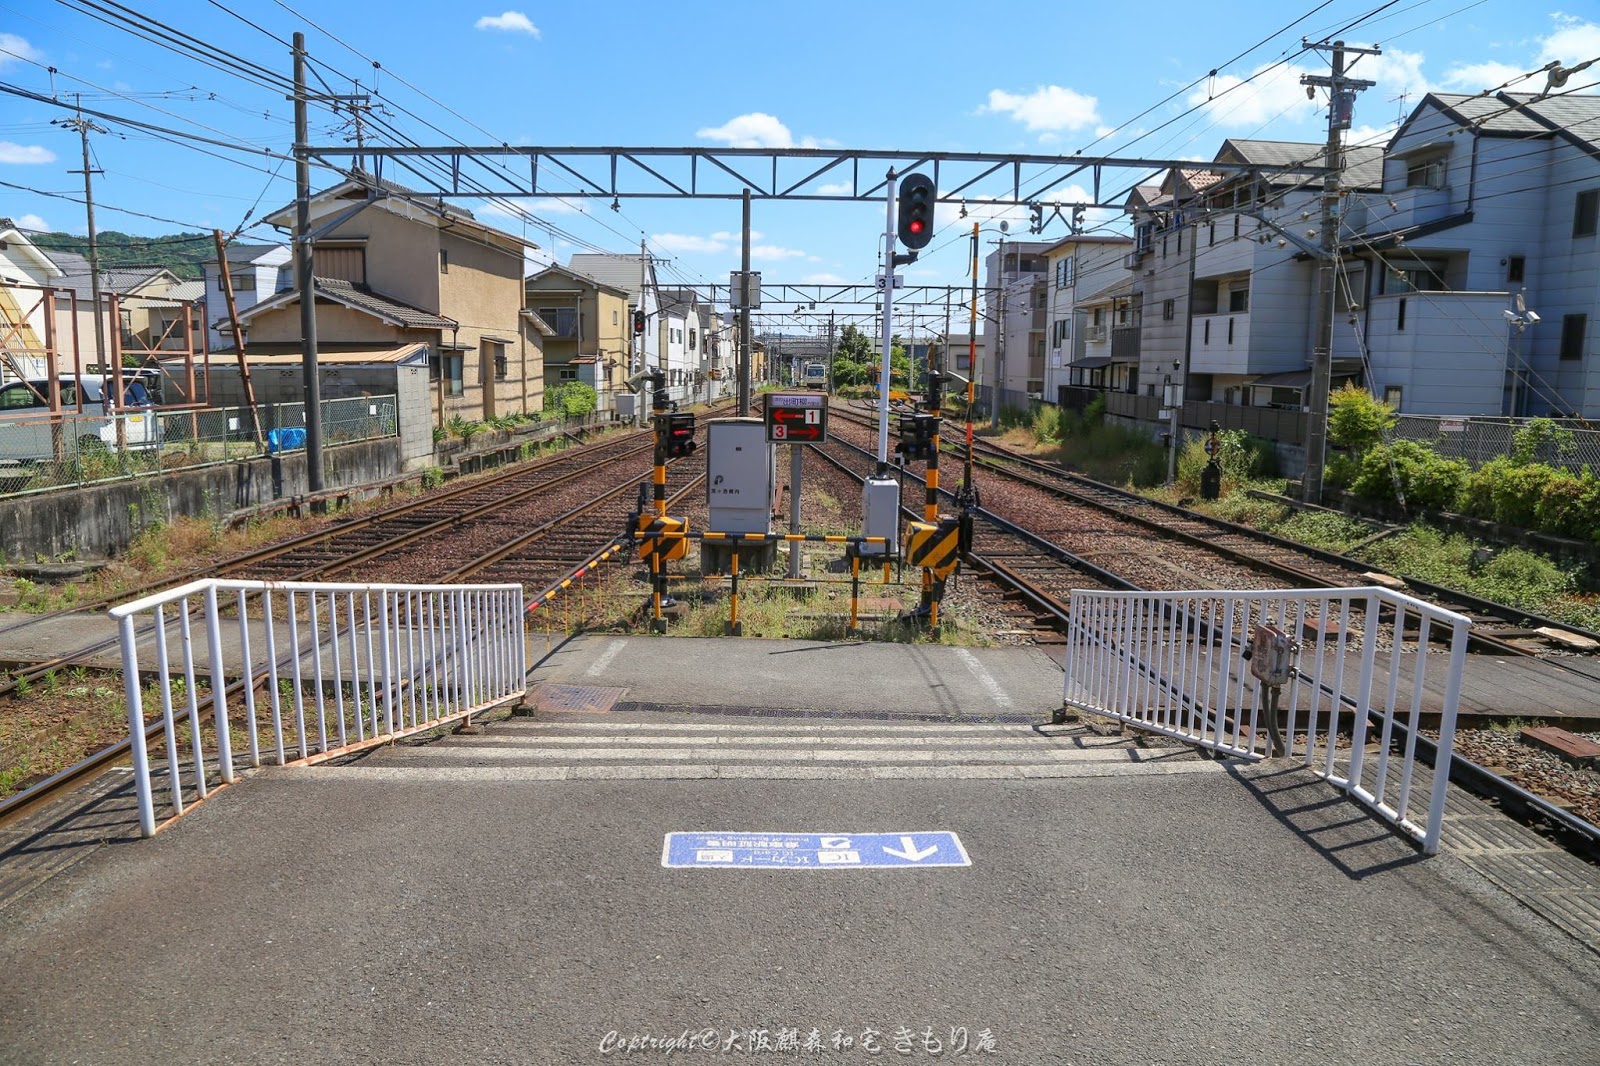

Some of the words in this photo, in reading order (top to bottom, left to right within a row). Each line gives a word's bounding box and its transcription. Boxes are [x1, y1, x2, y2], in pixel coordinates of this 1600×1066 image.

[892, 278, 900, 289] L
[808, 410, 815, 423] 1
[775, 426, 784, 438] 3
